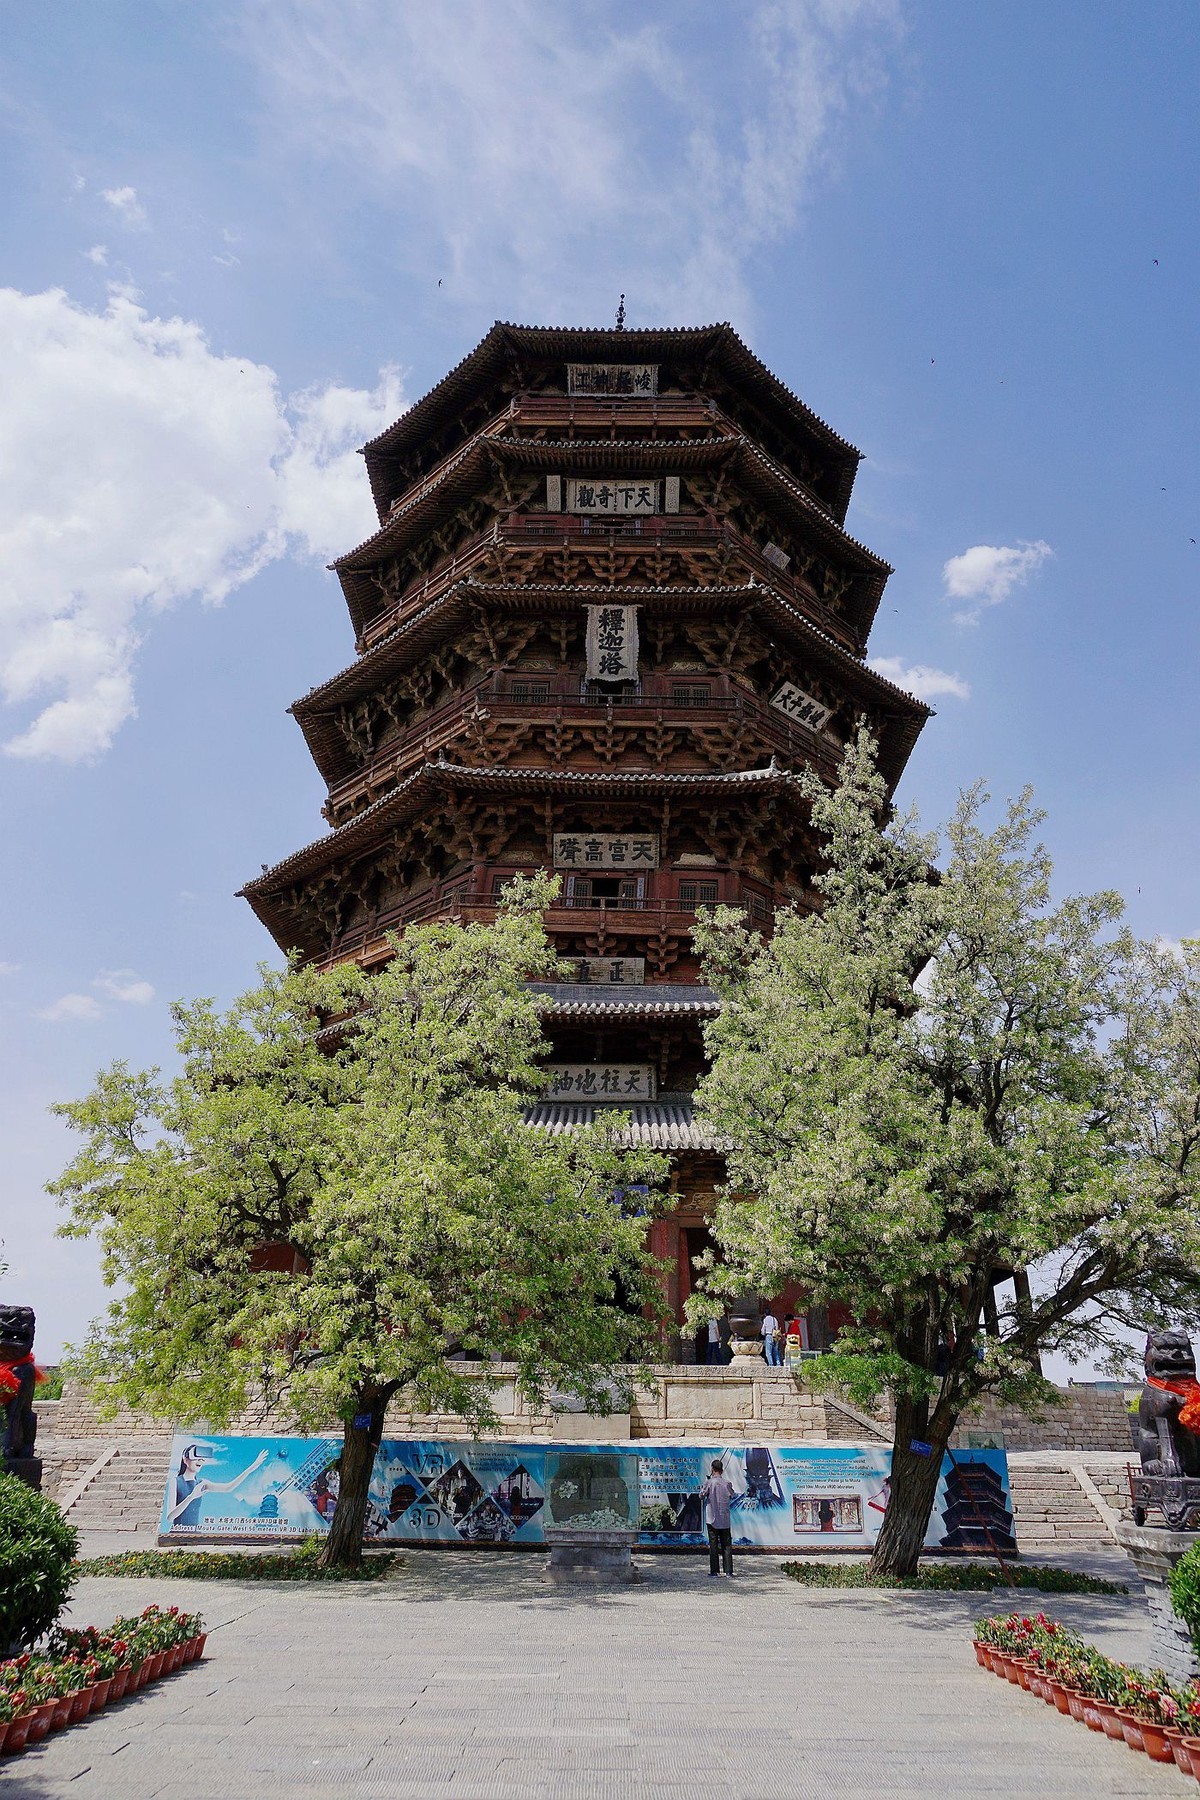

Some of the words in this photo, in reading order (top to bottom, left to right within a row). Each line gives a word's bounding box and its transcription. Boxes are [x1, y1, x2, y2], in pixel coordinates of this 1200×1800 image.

[577, 485, 655, 508] 天下奇觀
[598, 608, 628, 675] 釋迦塔
[413, 1454, 444, 1475] VR
[409, 1508, 441, 1529] 3D
